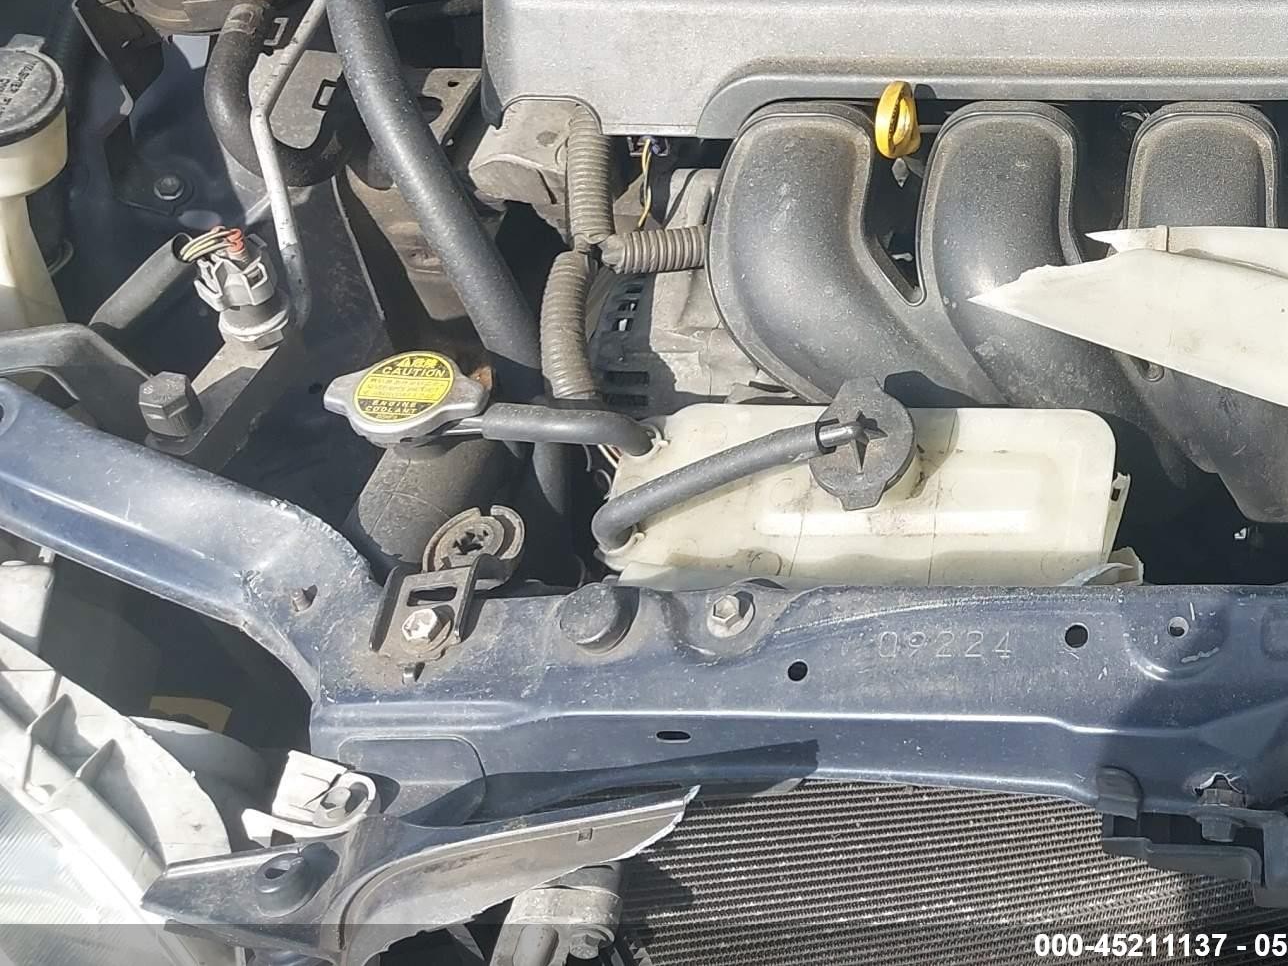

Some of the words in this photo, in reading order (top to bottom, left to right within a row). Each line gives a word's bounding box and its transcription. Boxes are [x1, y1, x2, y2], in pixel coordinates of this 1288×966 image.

[382, 366, 446, 377] CAUTION
[365, 406, 418, 414] COOLANT
[879, 630, 1013, 658] 09224
